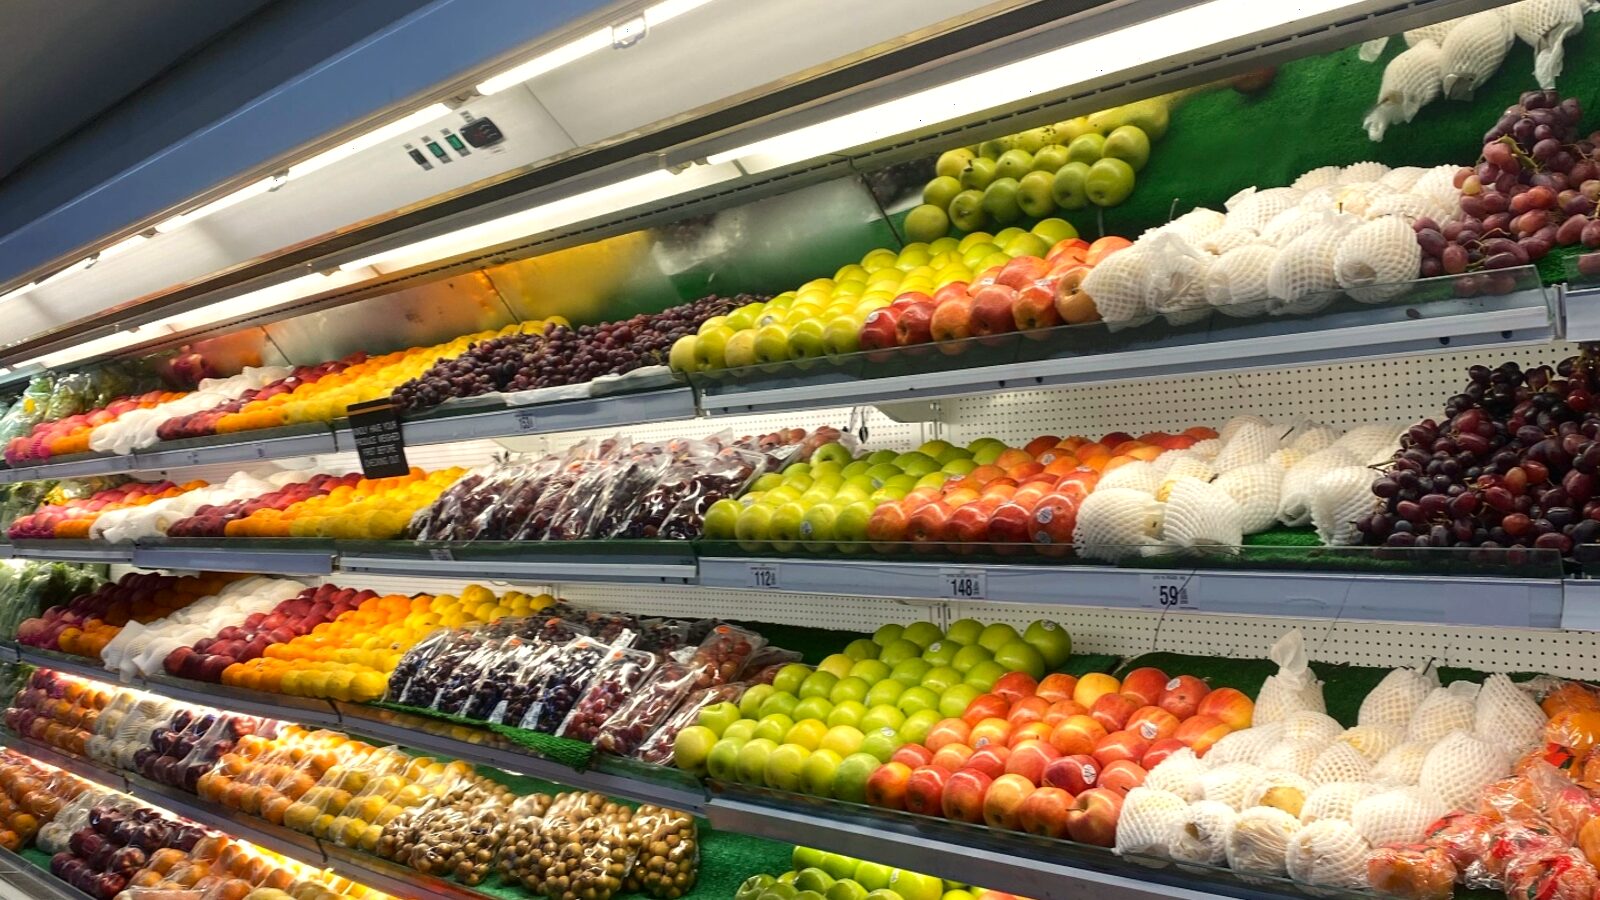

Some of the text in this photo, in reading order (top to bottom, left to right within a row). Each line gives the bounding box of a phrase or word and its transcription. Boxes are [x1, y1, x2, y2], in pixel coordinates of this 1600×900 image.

[754, 571, 771, 586] 112
[951, 579, 972, 596] 148
[1160, 585, 1178, 605] 59
